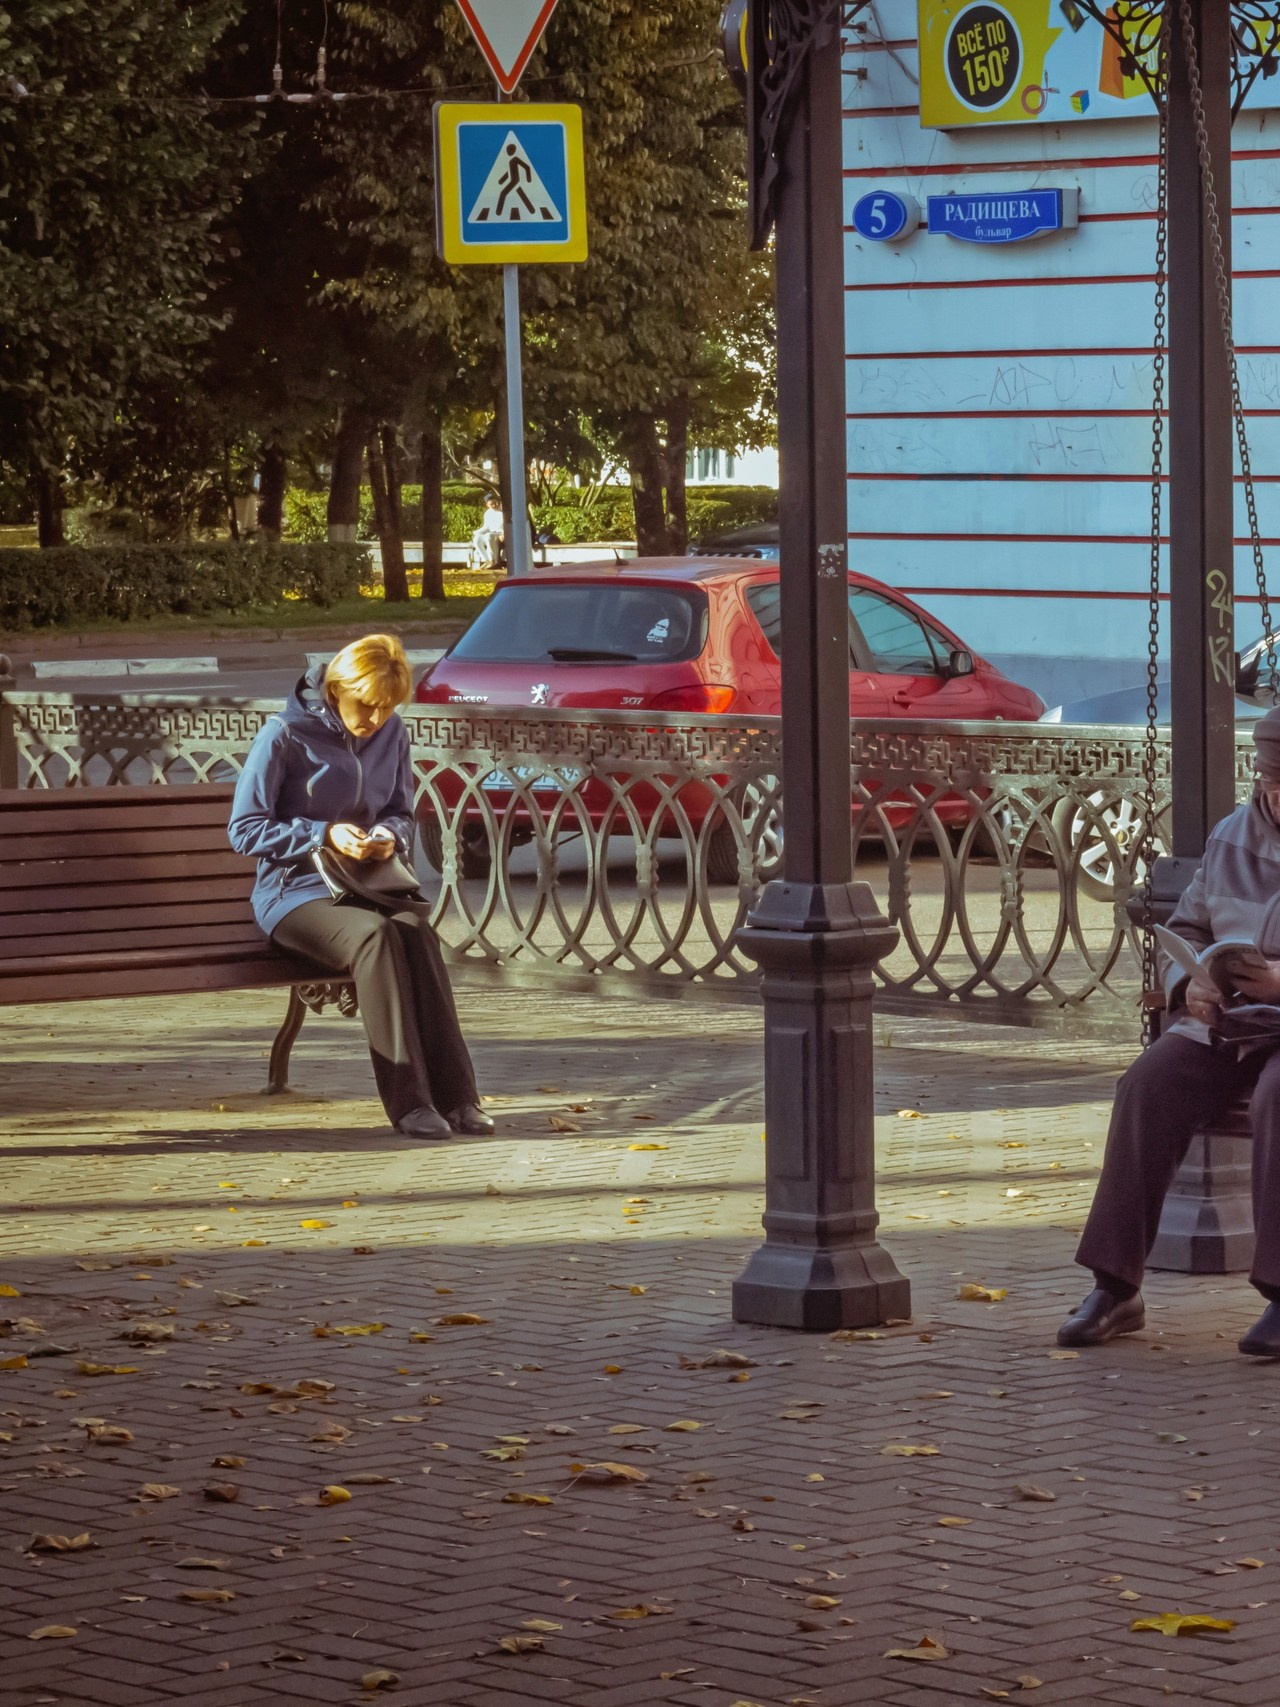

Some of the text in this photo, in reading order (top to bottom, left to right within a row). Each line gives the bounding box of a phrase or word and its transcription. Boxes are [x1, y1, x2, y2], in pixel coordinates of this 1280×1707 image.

[957, 19, 1006, 57] ВСЁ ПО
[871, 199, 887, 233] 5
[945, 200, 1040, 222] РАДИЩЕВА
[975, 225, 1012, 239] бульвар
[448, 695, 489, 703] PEUGEOT
[620, 697, 644, 705] 307
